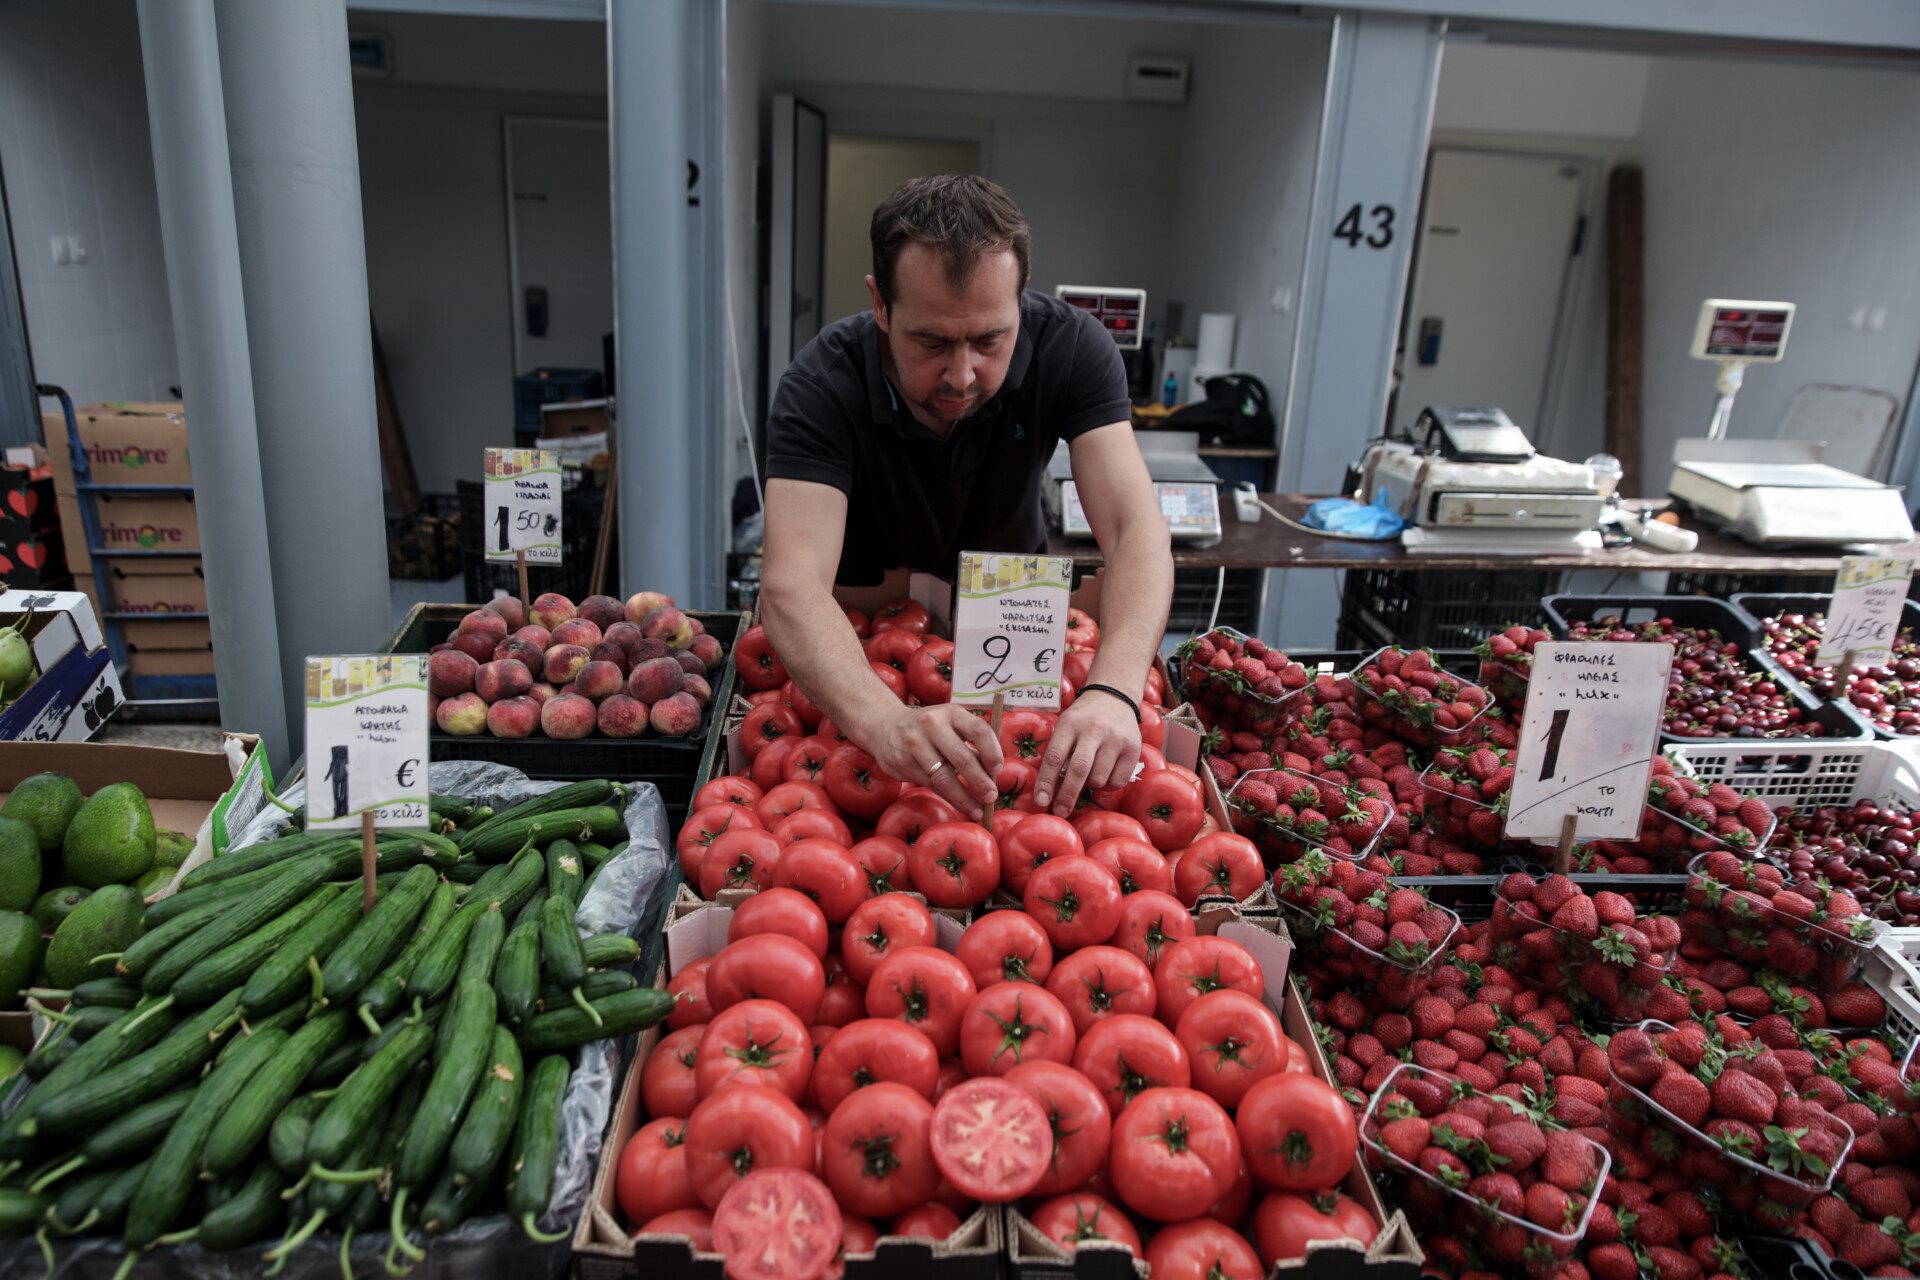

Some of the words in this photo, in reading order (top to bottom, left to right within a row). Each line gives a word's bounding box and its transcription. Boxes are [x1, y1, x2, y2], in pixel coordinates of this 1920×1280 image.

[1334, 202, 1395, 249] 43
[974, 635, 1013, 689] 2
[1033, 648, 1056, 673] €
[1009, 689, 1023, 698] το
[1027, 686, 1054, 699] κιλό
[324, 745, 349, 820] 1
[395, 758, 421, 788] €
[1598, 785, 1616, 795] ΤΟ
[373, 808, 388, 819] το
[391, 803, 423, 820] κιλό
